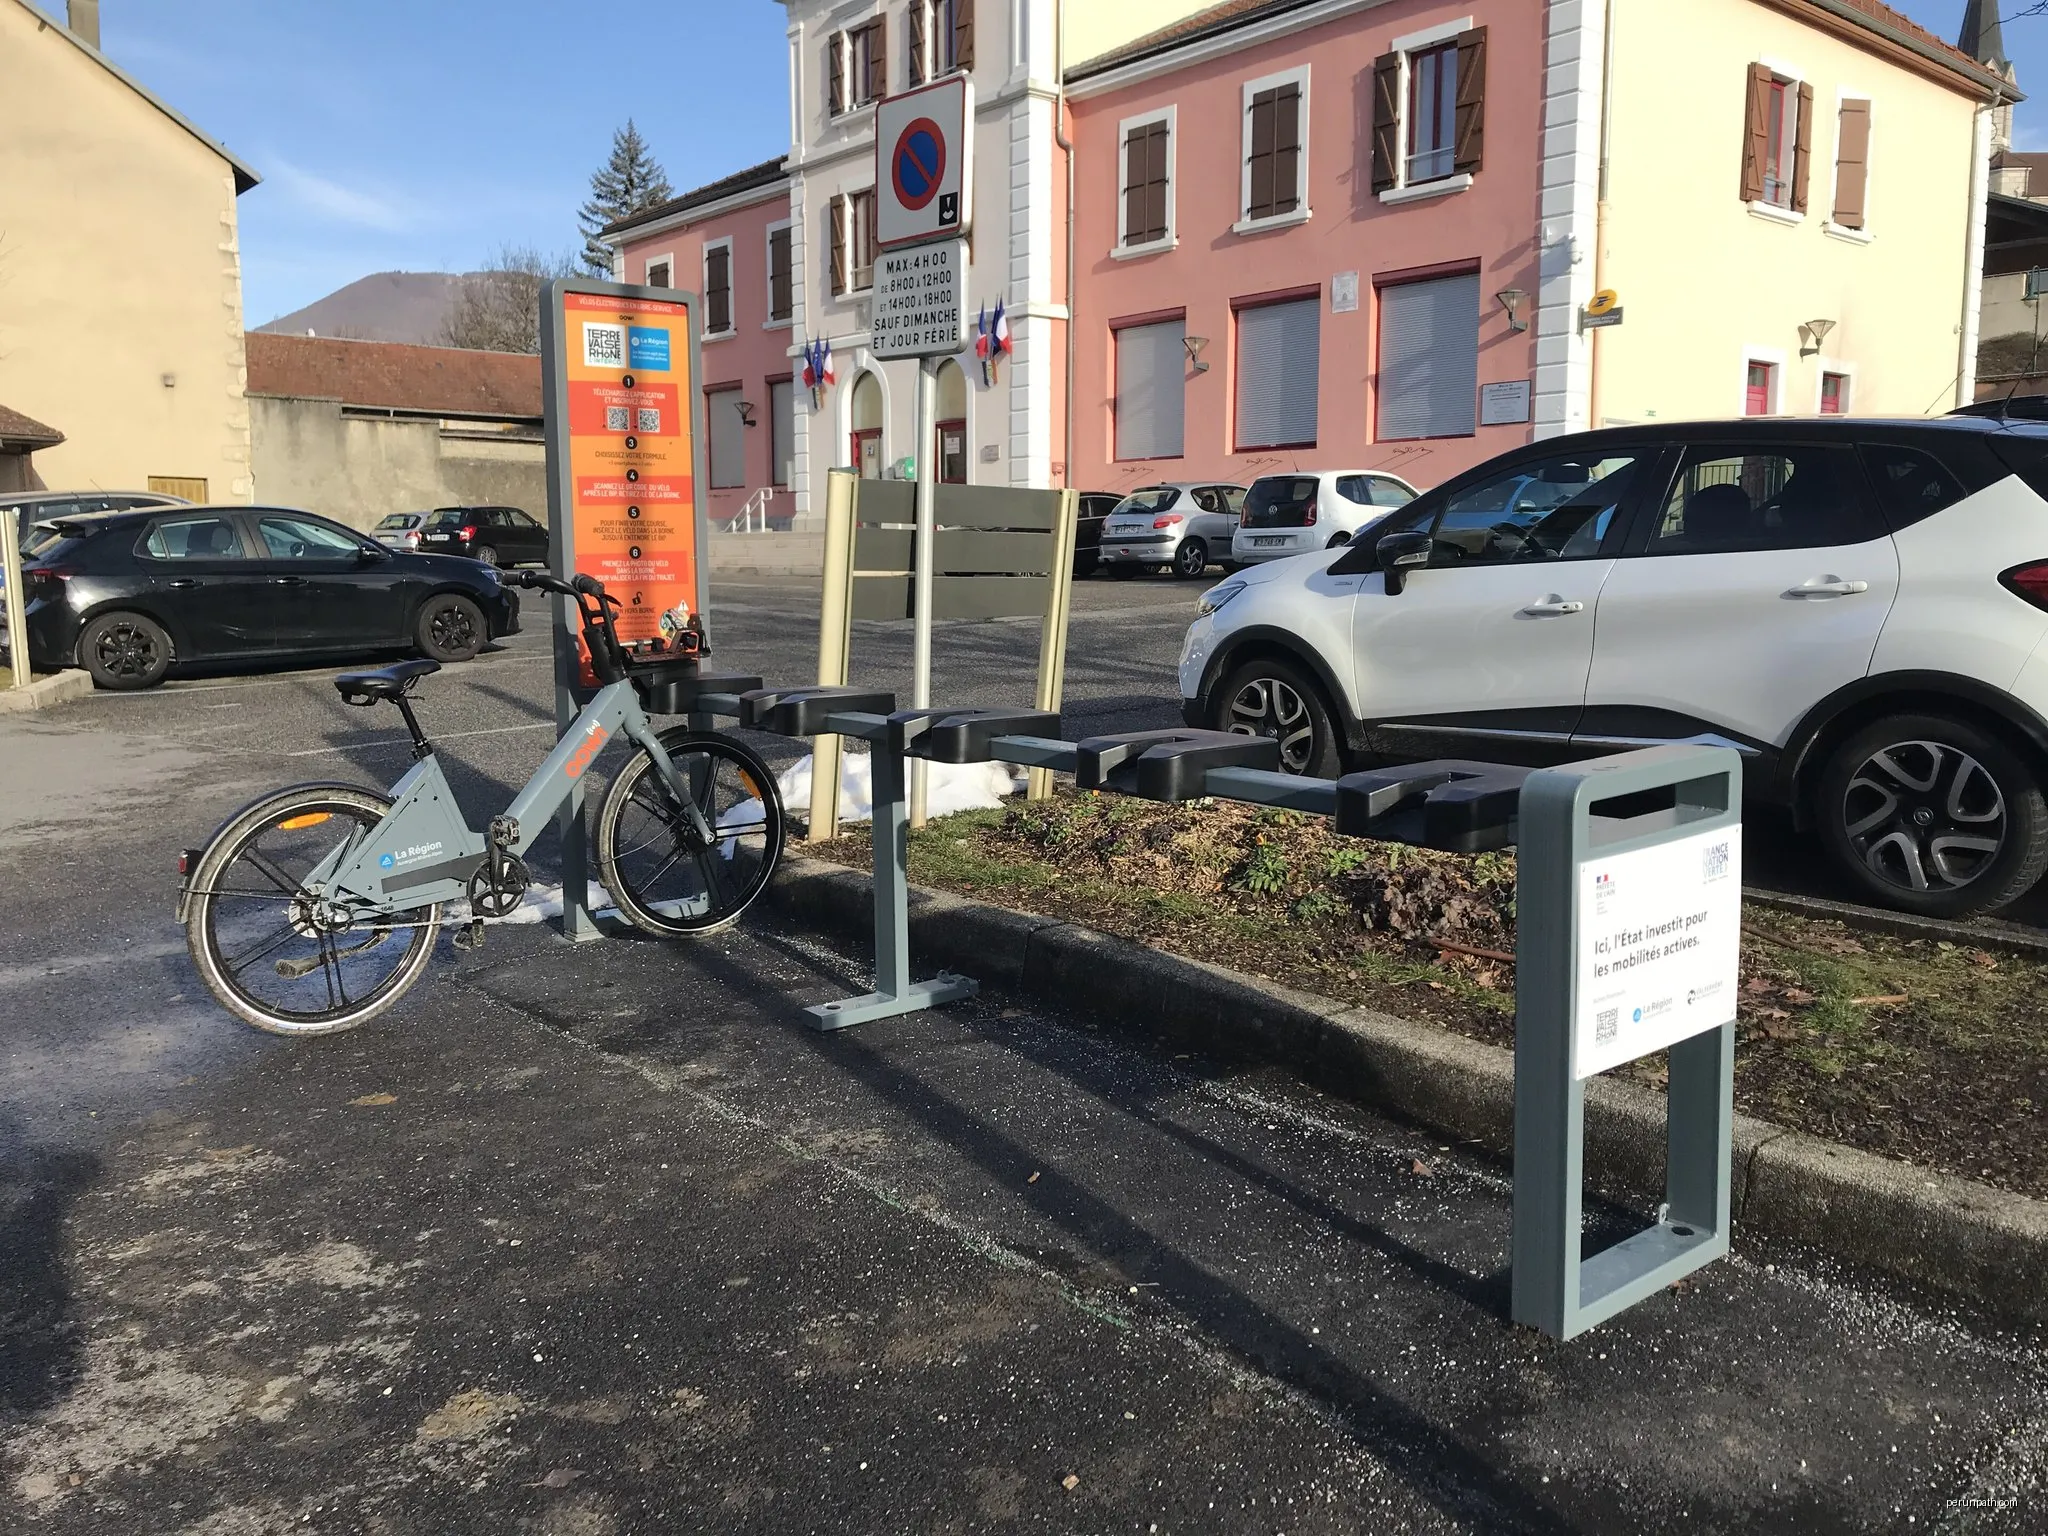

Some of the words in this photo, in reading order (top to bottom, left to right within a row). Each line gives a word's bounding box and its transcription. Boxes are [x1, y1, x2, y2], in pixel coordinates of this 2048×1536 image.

[880, 285, 888, 294] DE
[890, 276, 914, 292] 8H00
[923, 270, 951, 286] 12H00
[880, 304, 886, 312] ET
[889, 296, 916, 310] 14H00
[924, 290, 952, 306] 18H00
[874, 316, 900, 331] SAUF
[904, 308, 957, 327] DIMANCHE
[587, 329, 620, 340] TERRE
[874, 336, 886, 349] ET
[890, 332, 920, 347] JOUR
[924, 325, 957, 344] FÉRIÉ
[588, 339, 621, 350] VALSE
[627, 378, 630, 386] 1
[629, 439, 634, 447] 3
[631, 508, 637, 517] 5
[632, 549, 638, 557] 6
[394, 851, 407, 859] La
[408, 841, 442, 856] Région
[1595, 937, 1611, 954] Ici,
[1615, 928, 1642, 949] l'État
[1646, 916, 1683, 940] investit
[1686, 910, 1708, 931] pour
[1594, 963, 1608, 978] les
[1613, 945, 1660, 972] mobilités
[1663, 936, 1700, 956] actives.
[1643, 1005, 1650, 1014] La
[1651, 998, 1672, 1010] Région
[1596, 1007, 1618, 1022] TERRE
[1596, 1019, 1618, 1032] VALSE
